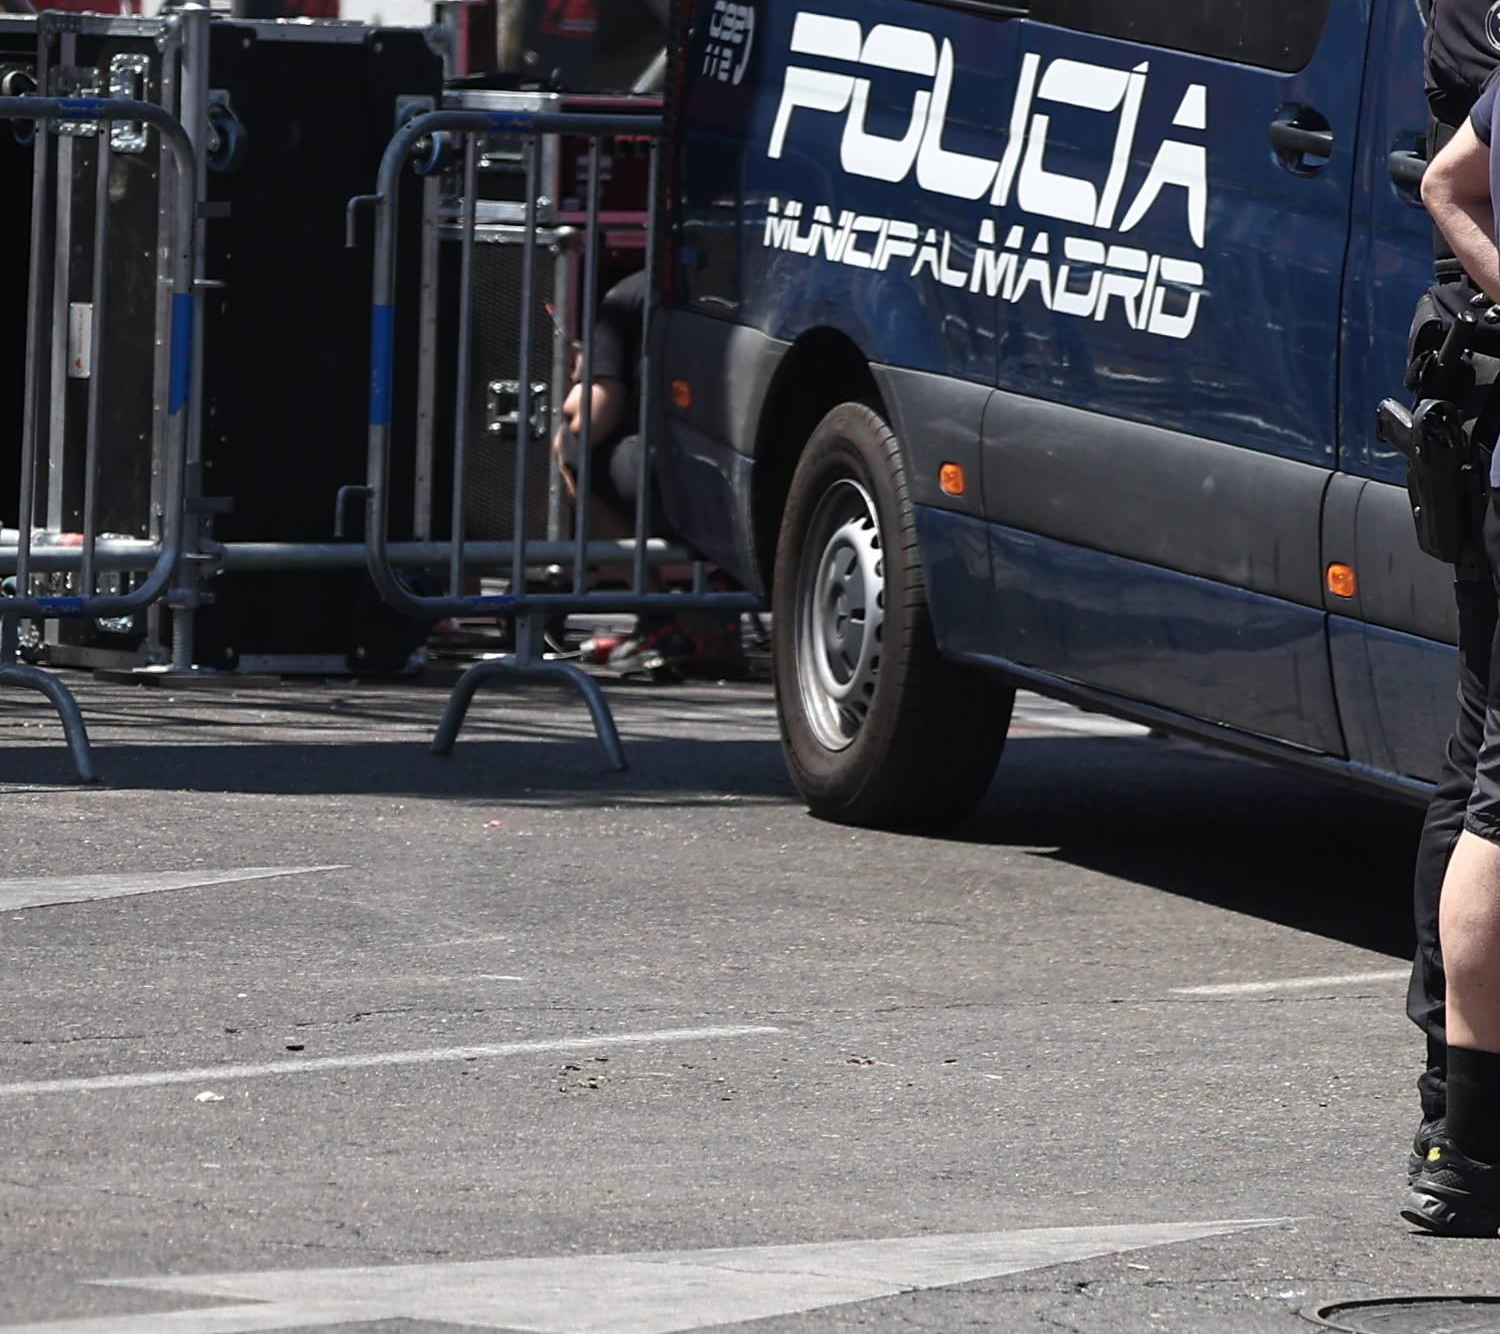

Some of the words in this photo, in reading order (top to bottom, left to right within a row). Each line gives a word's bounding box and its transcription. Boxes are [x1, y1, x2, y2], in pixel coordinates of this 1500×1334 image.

[702, 43, 733, 82] 112
[763, 197, 968, 287] MUNICIPAL
[969, 219, 1204, 339] MADRID
